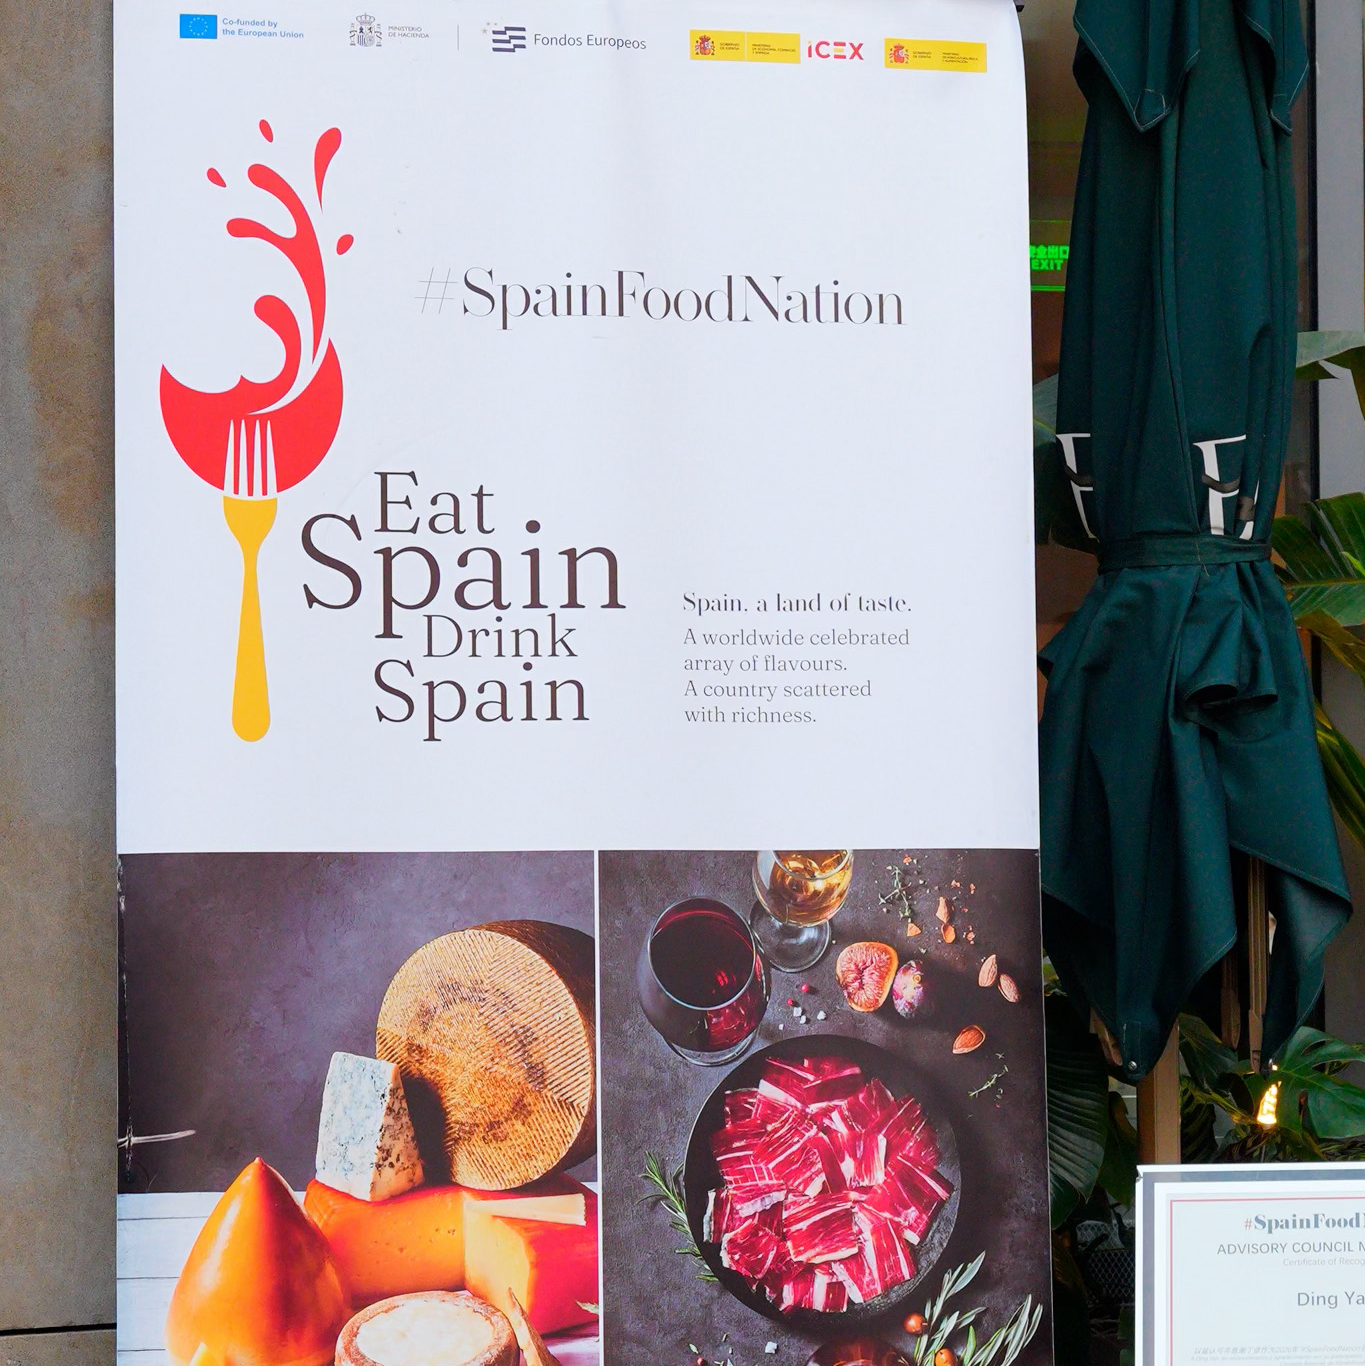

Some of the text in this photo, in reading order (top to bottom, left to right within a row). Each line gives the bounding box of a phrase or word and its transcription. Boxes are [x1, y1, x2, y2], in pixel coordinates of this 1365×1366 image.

[222, 18, 278, 28] Co-funded by
[238, 30, 277, 38] European
[534, 34, 647, 50] Fondos Europeos
[1031, 259, 1064, 270] EXIT
[414, 266, 907, 331] #SpainFoodNation
[373, 470, 496, 535] Eat
[300, 512, 628, 640] Spain
[756, 596, 768, 612] a
[776, 592, 821, 612] land
[829, 592, 851, 612] of
[858, 594, 912, 613] taste.
[421, 612, 579, 659] Drink
[683, 628, 910, 646] A worldwide celebrated
[684, 654, 848, 676] array of flavours.
[374, 658, 590, 742] Spain
[684, 680, 872, 702] A country scattered
[684, 706, 817, 723] with richness.
[1217, 1242, 1288, 1255] ADVISORY
[1292, 1241, 1355, 1254] COUNCIL
[1283, 1257, 1327, 1267] Certificate
[1329, 1256, 1337, 1266] of
[1296, 1291, 1339, 1309] Ding
